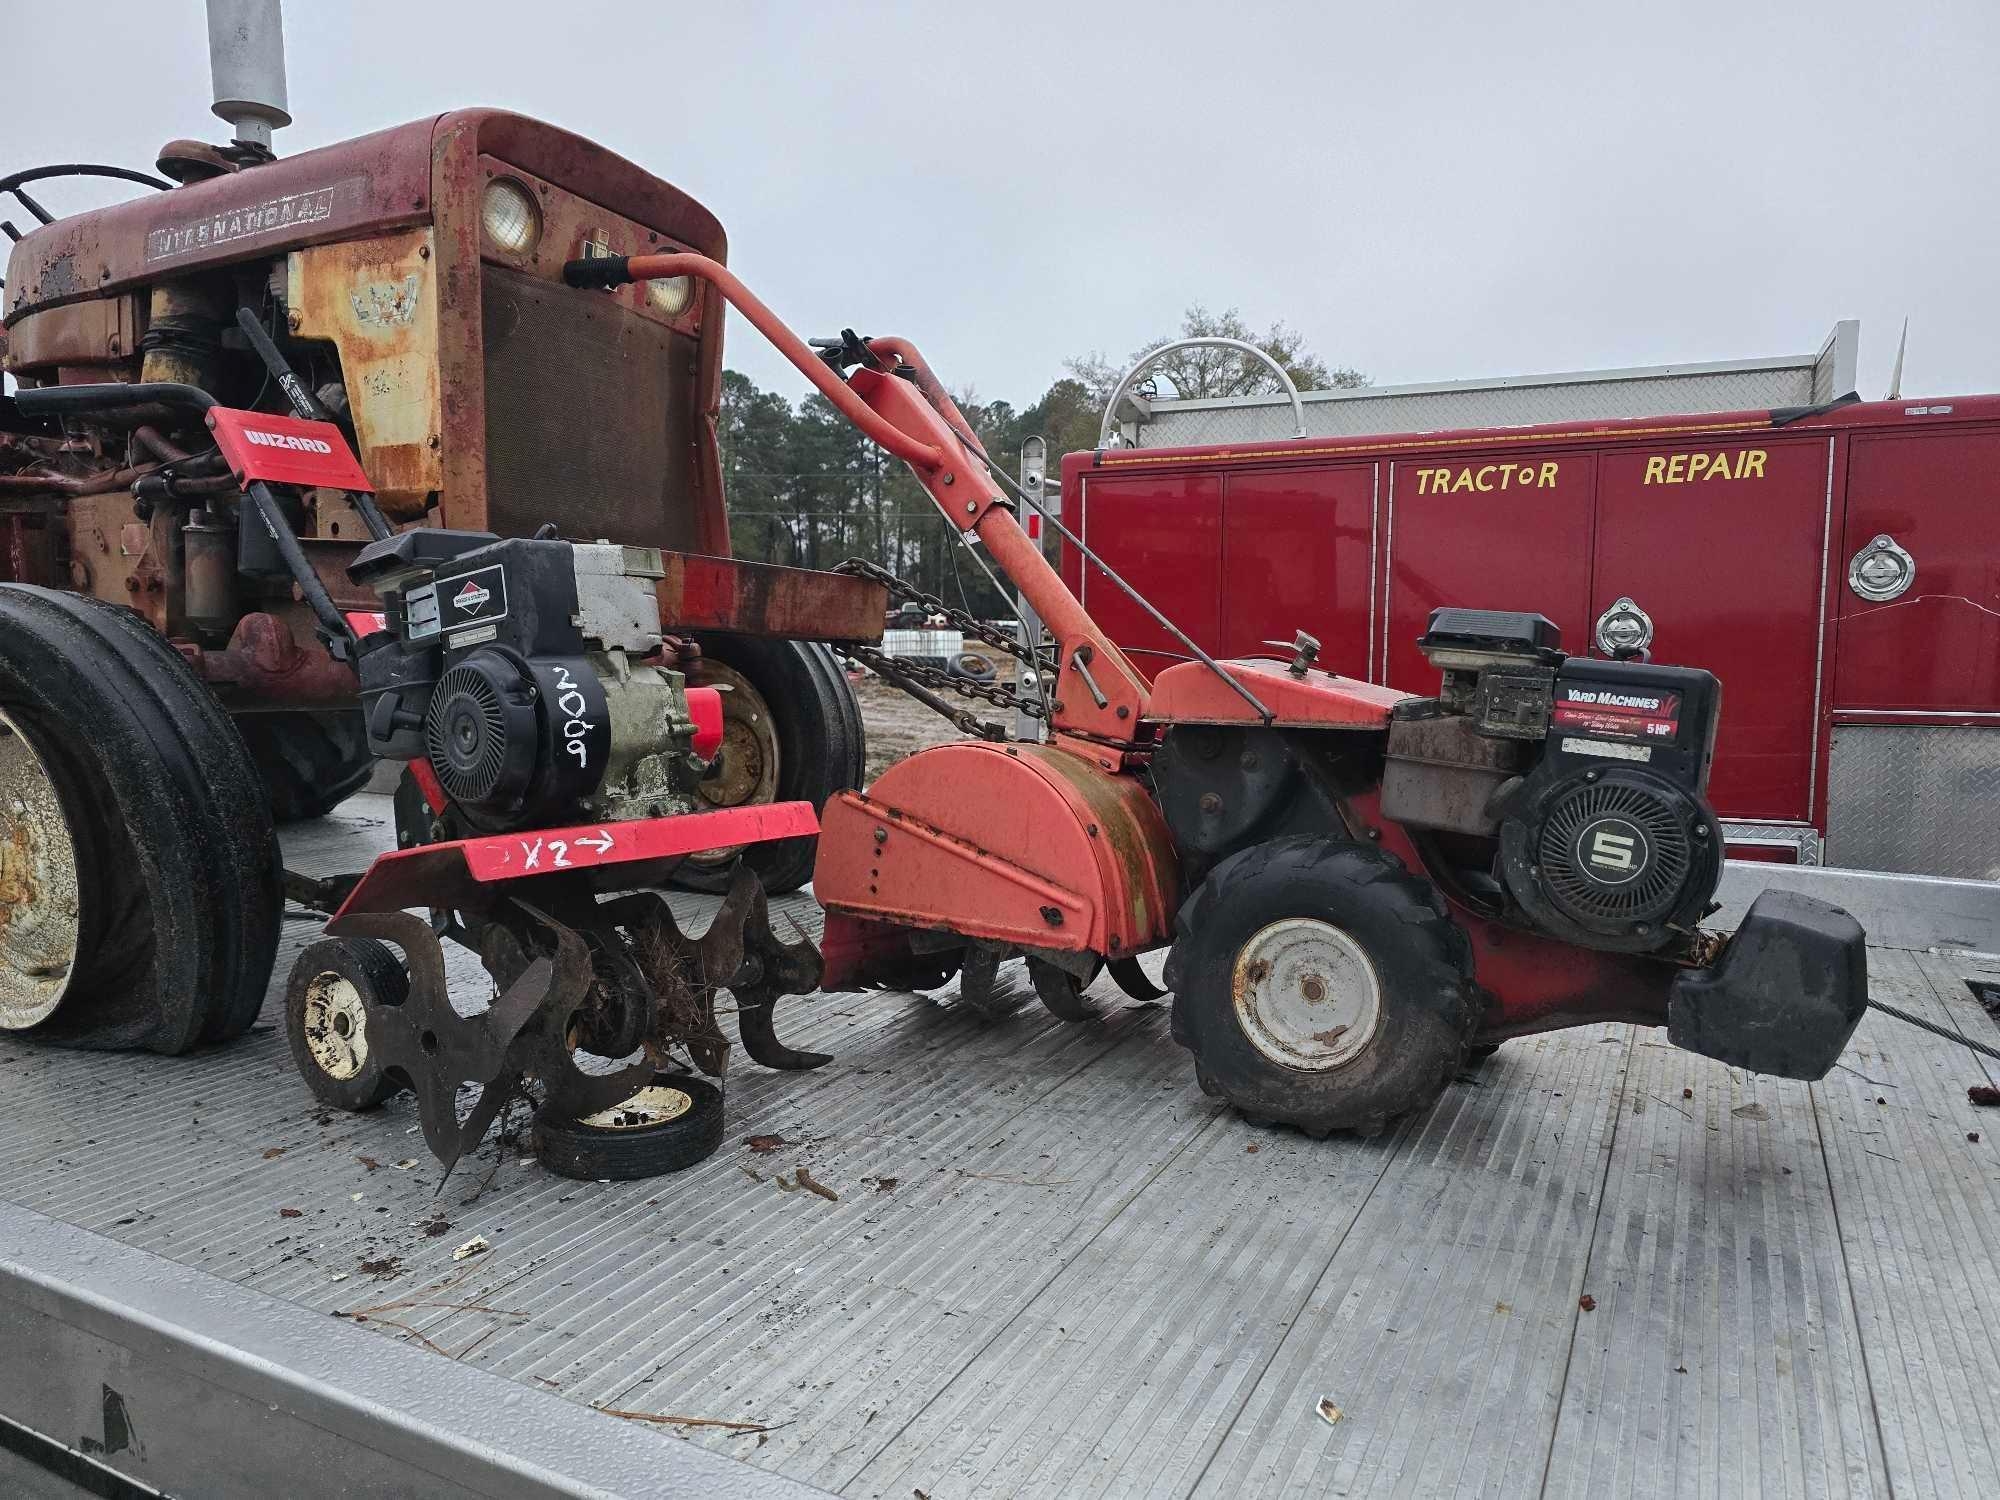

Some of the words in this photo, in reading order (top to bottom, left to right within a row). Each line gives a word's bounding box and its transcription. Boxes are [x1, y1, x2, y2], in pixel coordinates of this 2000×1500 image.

[243, 429, 331, 454] WIZARD
[1643, 450, 1768, 485] REPAIR
[1567, 689, 1596, 703] YARD
[1599, 692, 1660, 710] MACHINES
[1646, 723, 1655, 734] 5
[1655, 724, 1671, 735] HP
[1591, 831, 1634, 869] 5
